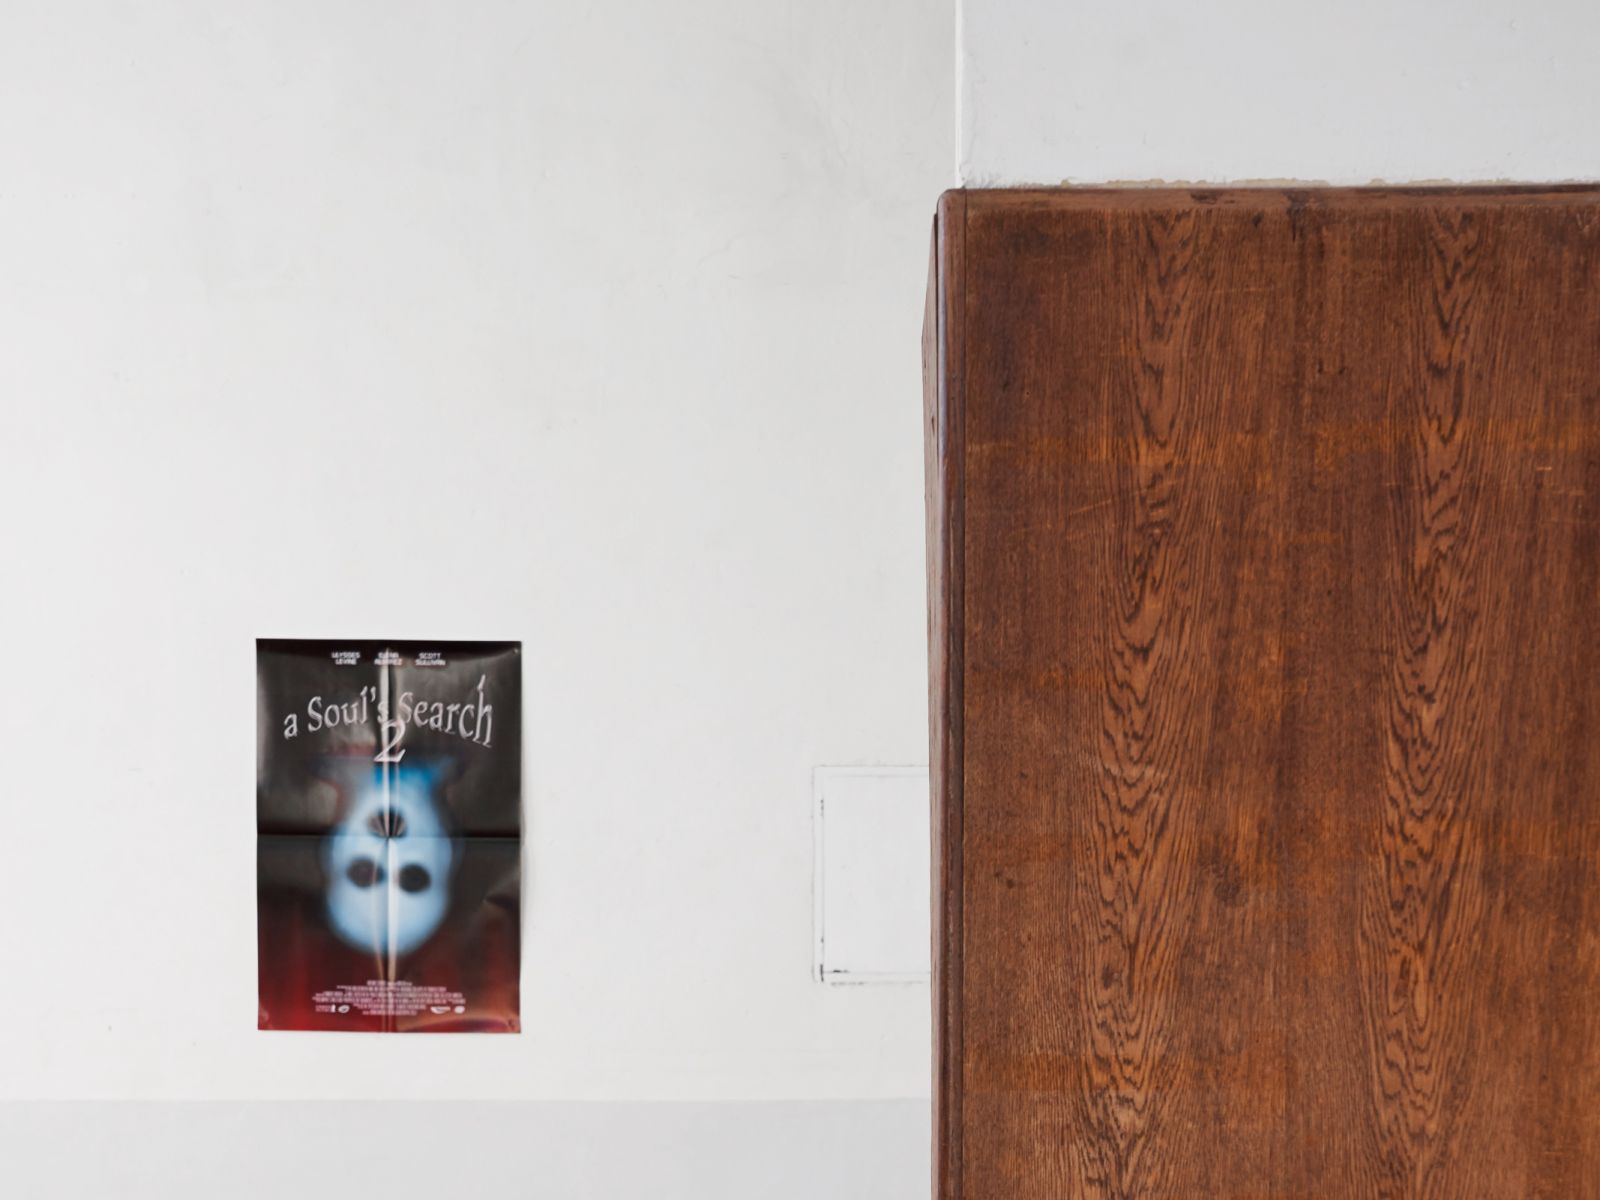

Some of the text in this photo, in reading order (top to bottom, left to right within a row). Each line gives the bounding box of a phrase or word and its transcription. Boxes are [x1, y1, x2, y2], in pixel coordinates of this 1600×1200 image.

[283, 674, 494, 748] a Soul's Search
[374, 718, 407, 763] 2
